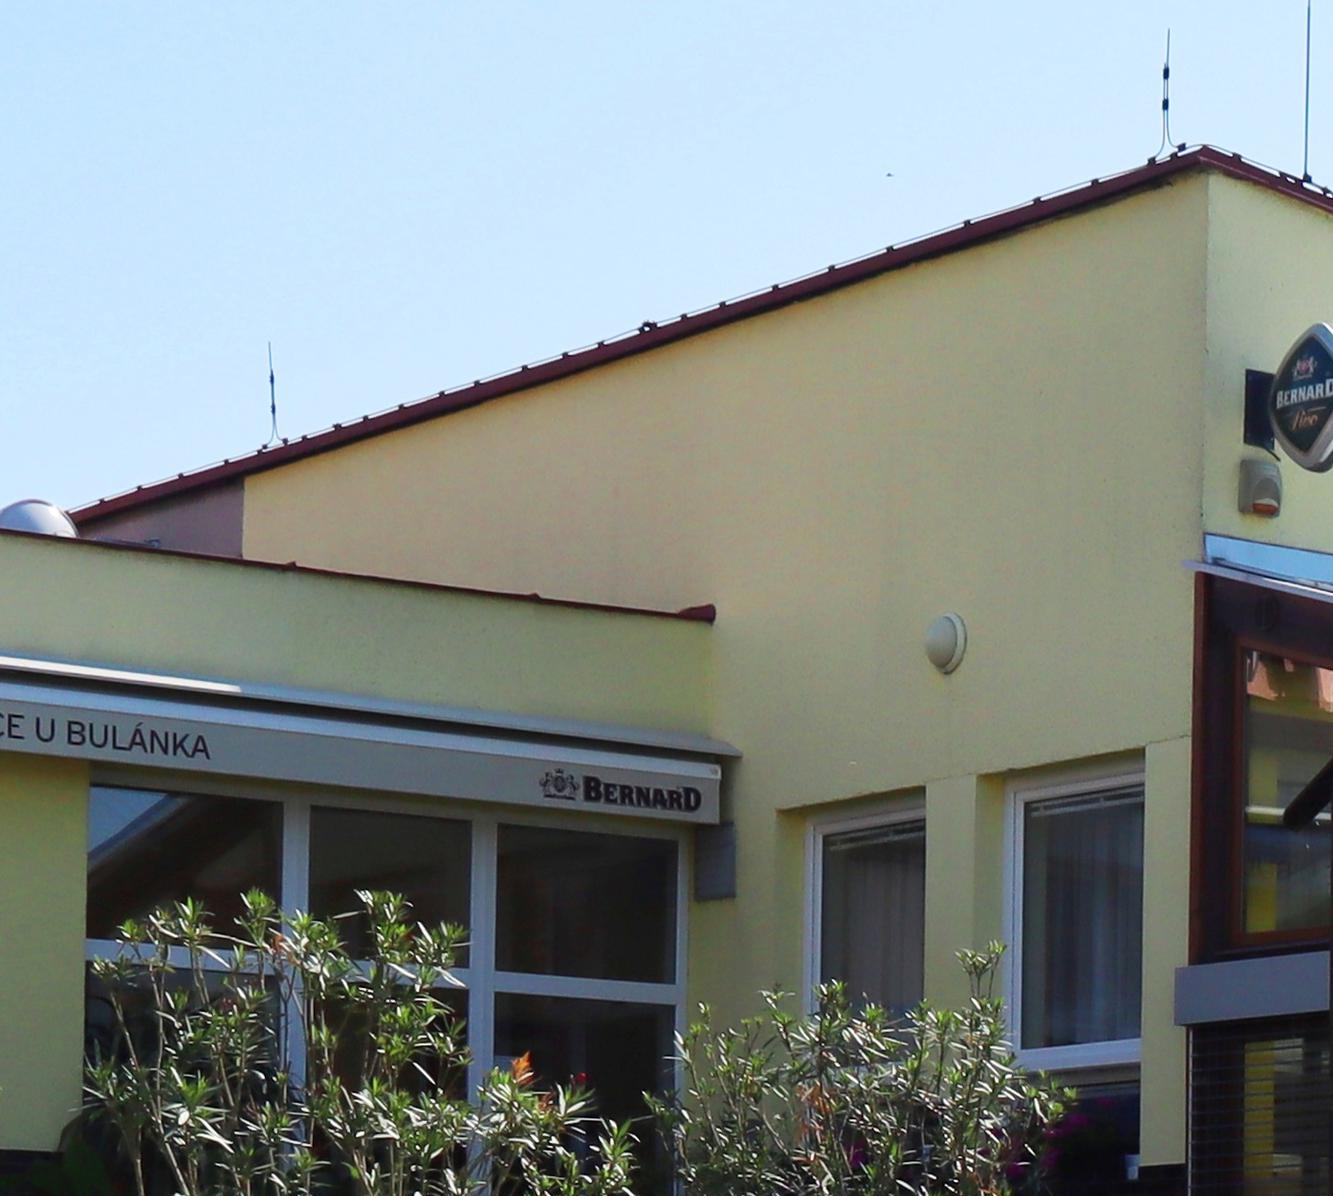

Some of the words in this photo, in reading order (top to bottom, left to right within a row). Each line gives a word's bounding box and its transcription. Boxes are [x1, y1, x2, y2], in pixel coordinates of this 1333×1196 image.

[0, 713, 26, 741] E
[35, 716, 56, 743] U
[66, 722, 211, 761] BULÁNKA
[582, 775, 702, 813] BERNARD
